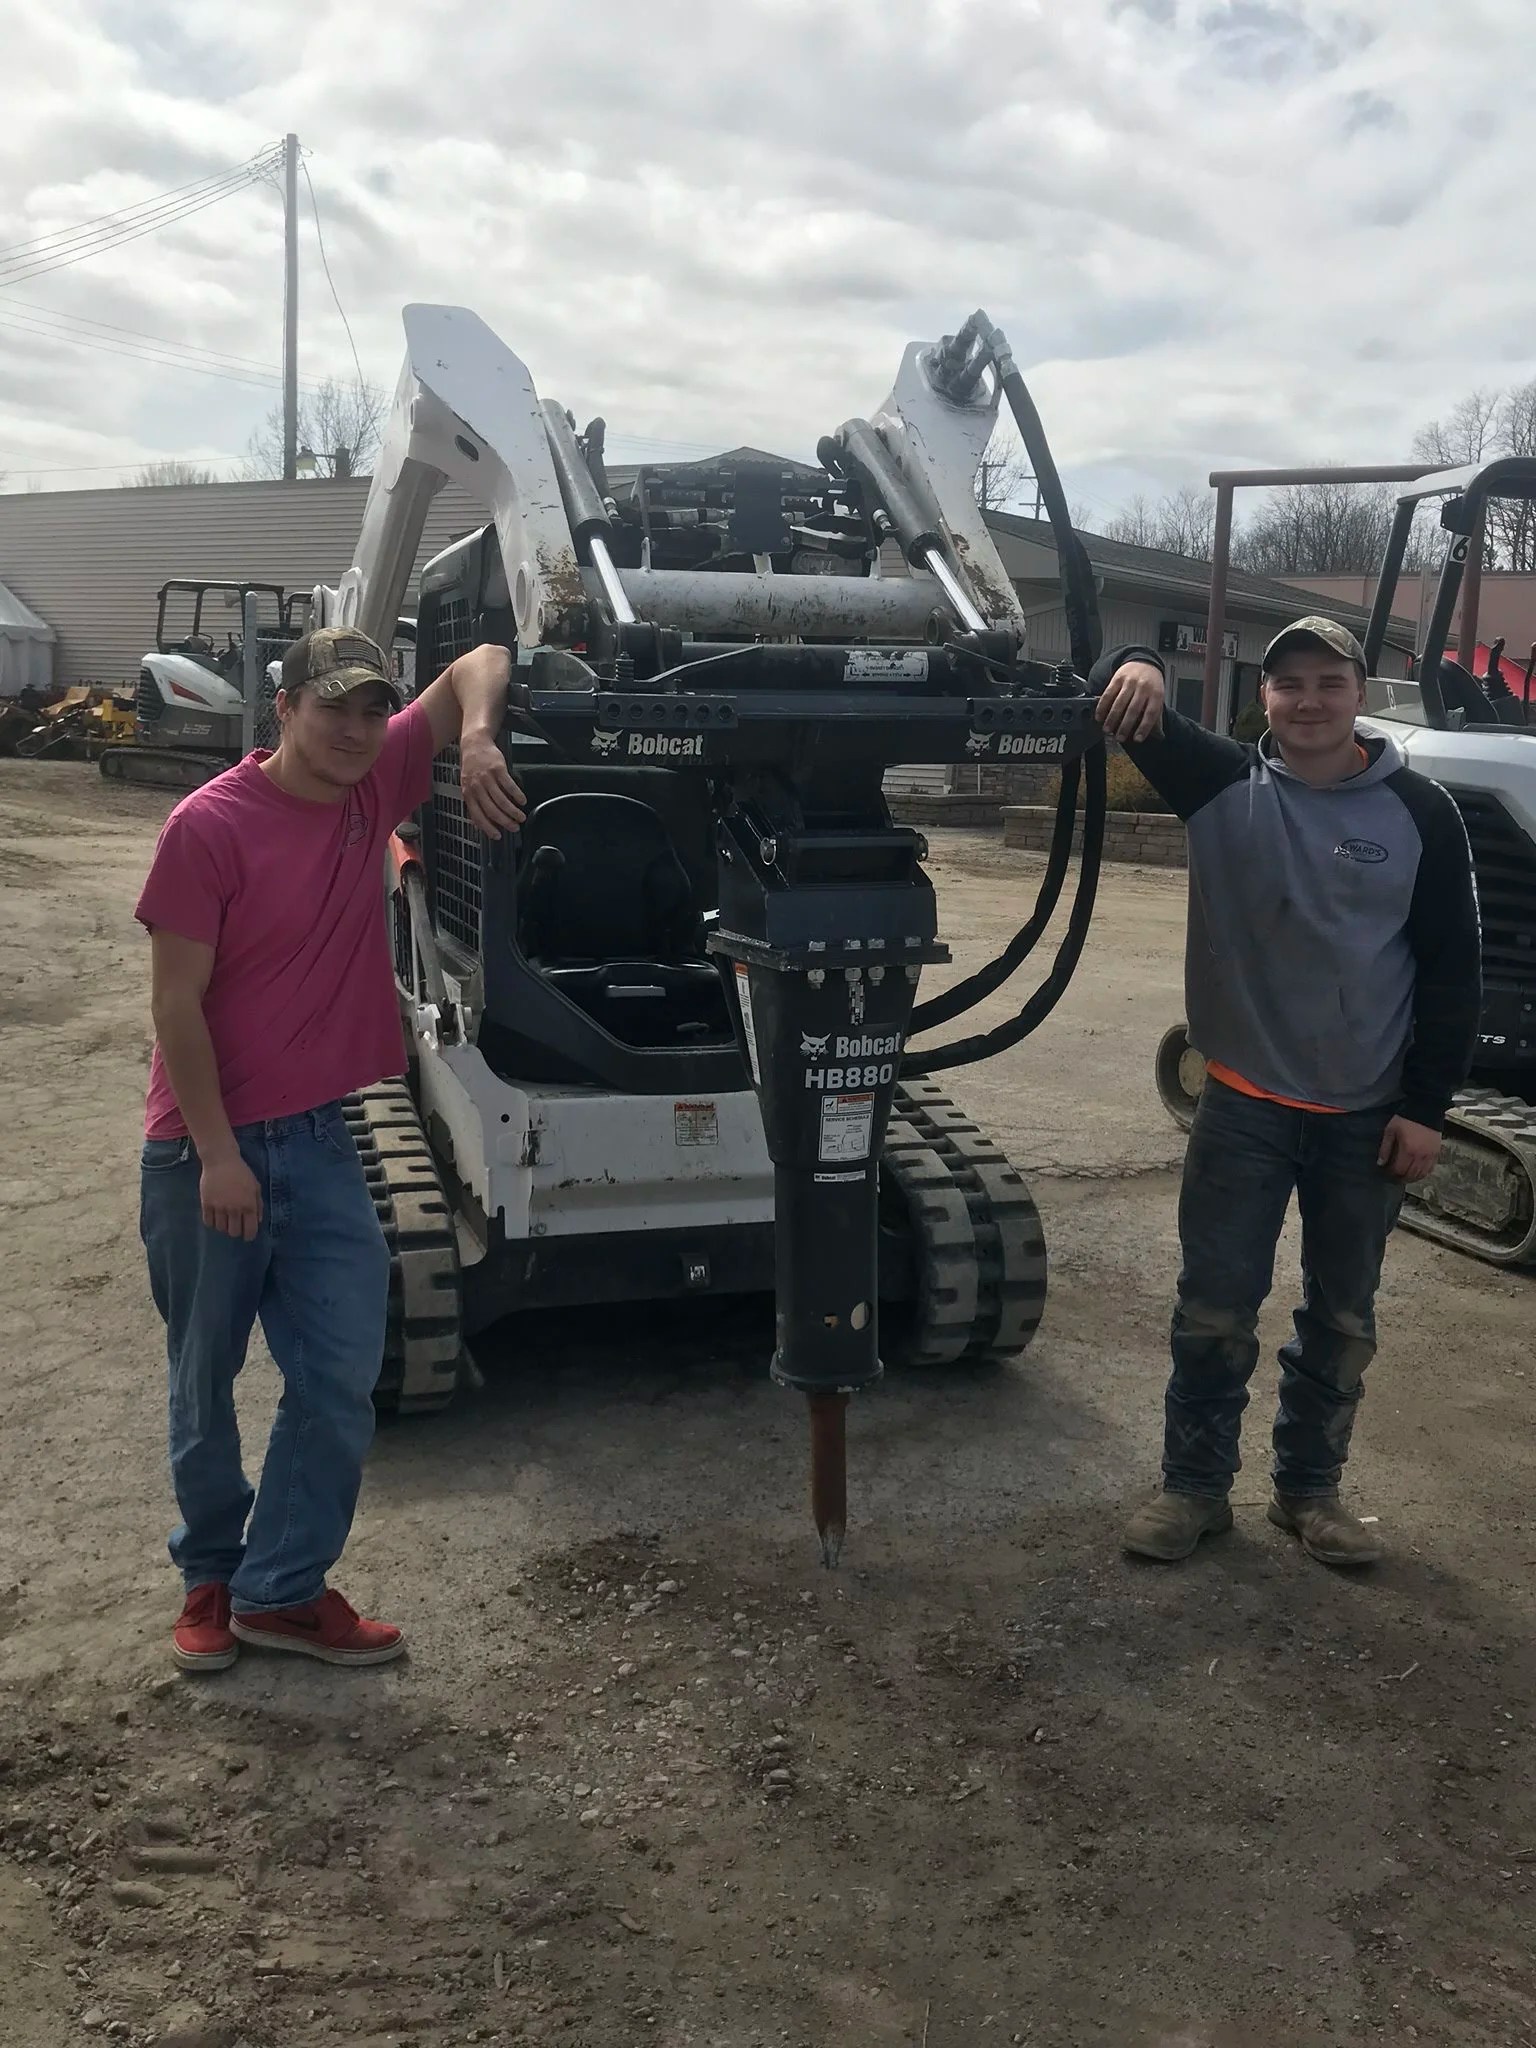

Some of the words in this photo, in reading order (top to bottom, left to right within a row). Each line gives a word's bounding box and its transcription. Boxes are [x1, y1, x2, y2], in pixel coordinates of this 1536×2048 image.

[1452, 536, 1469, 561] 6
[628, 733, 704, 755] Bobcat
[998, 734, 1067, 754] Bobcat
[836, 1032, 901, 1058] Bobcat
[805, 1064, 893, 1089] HB880
